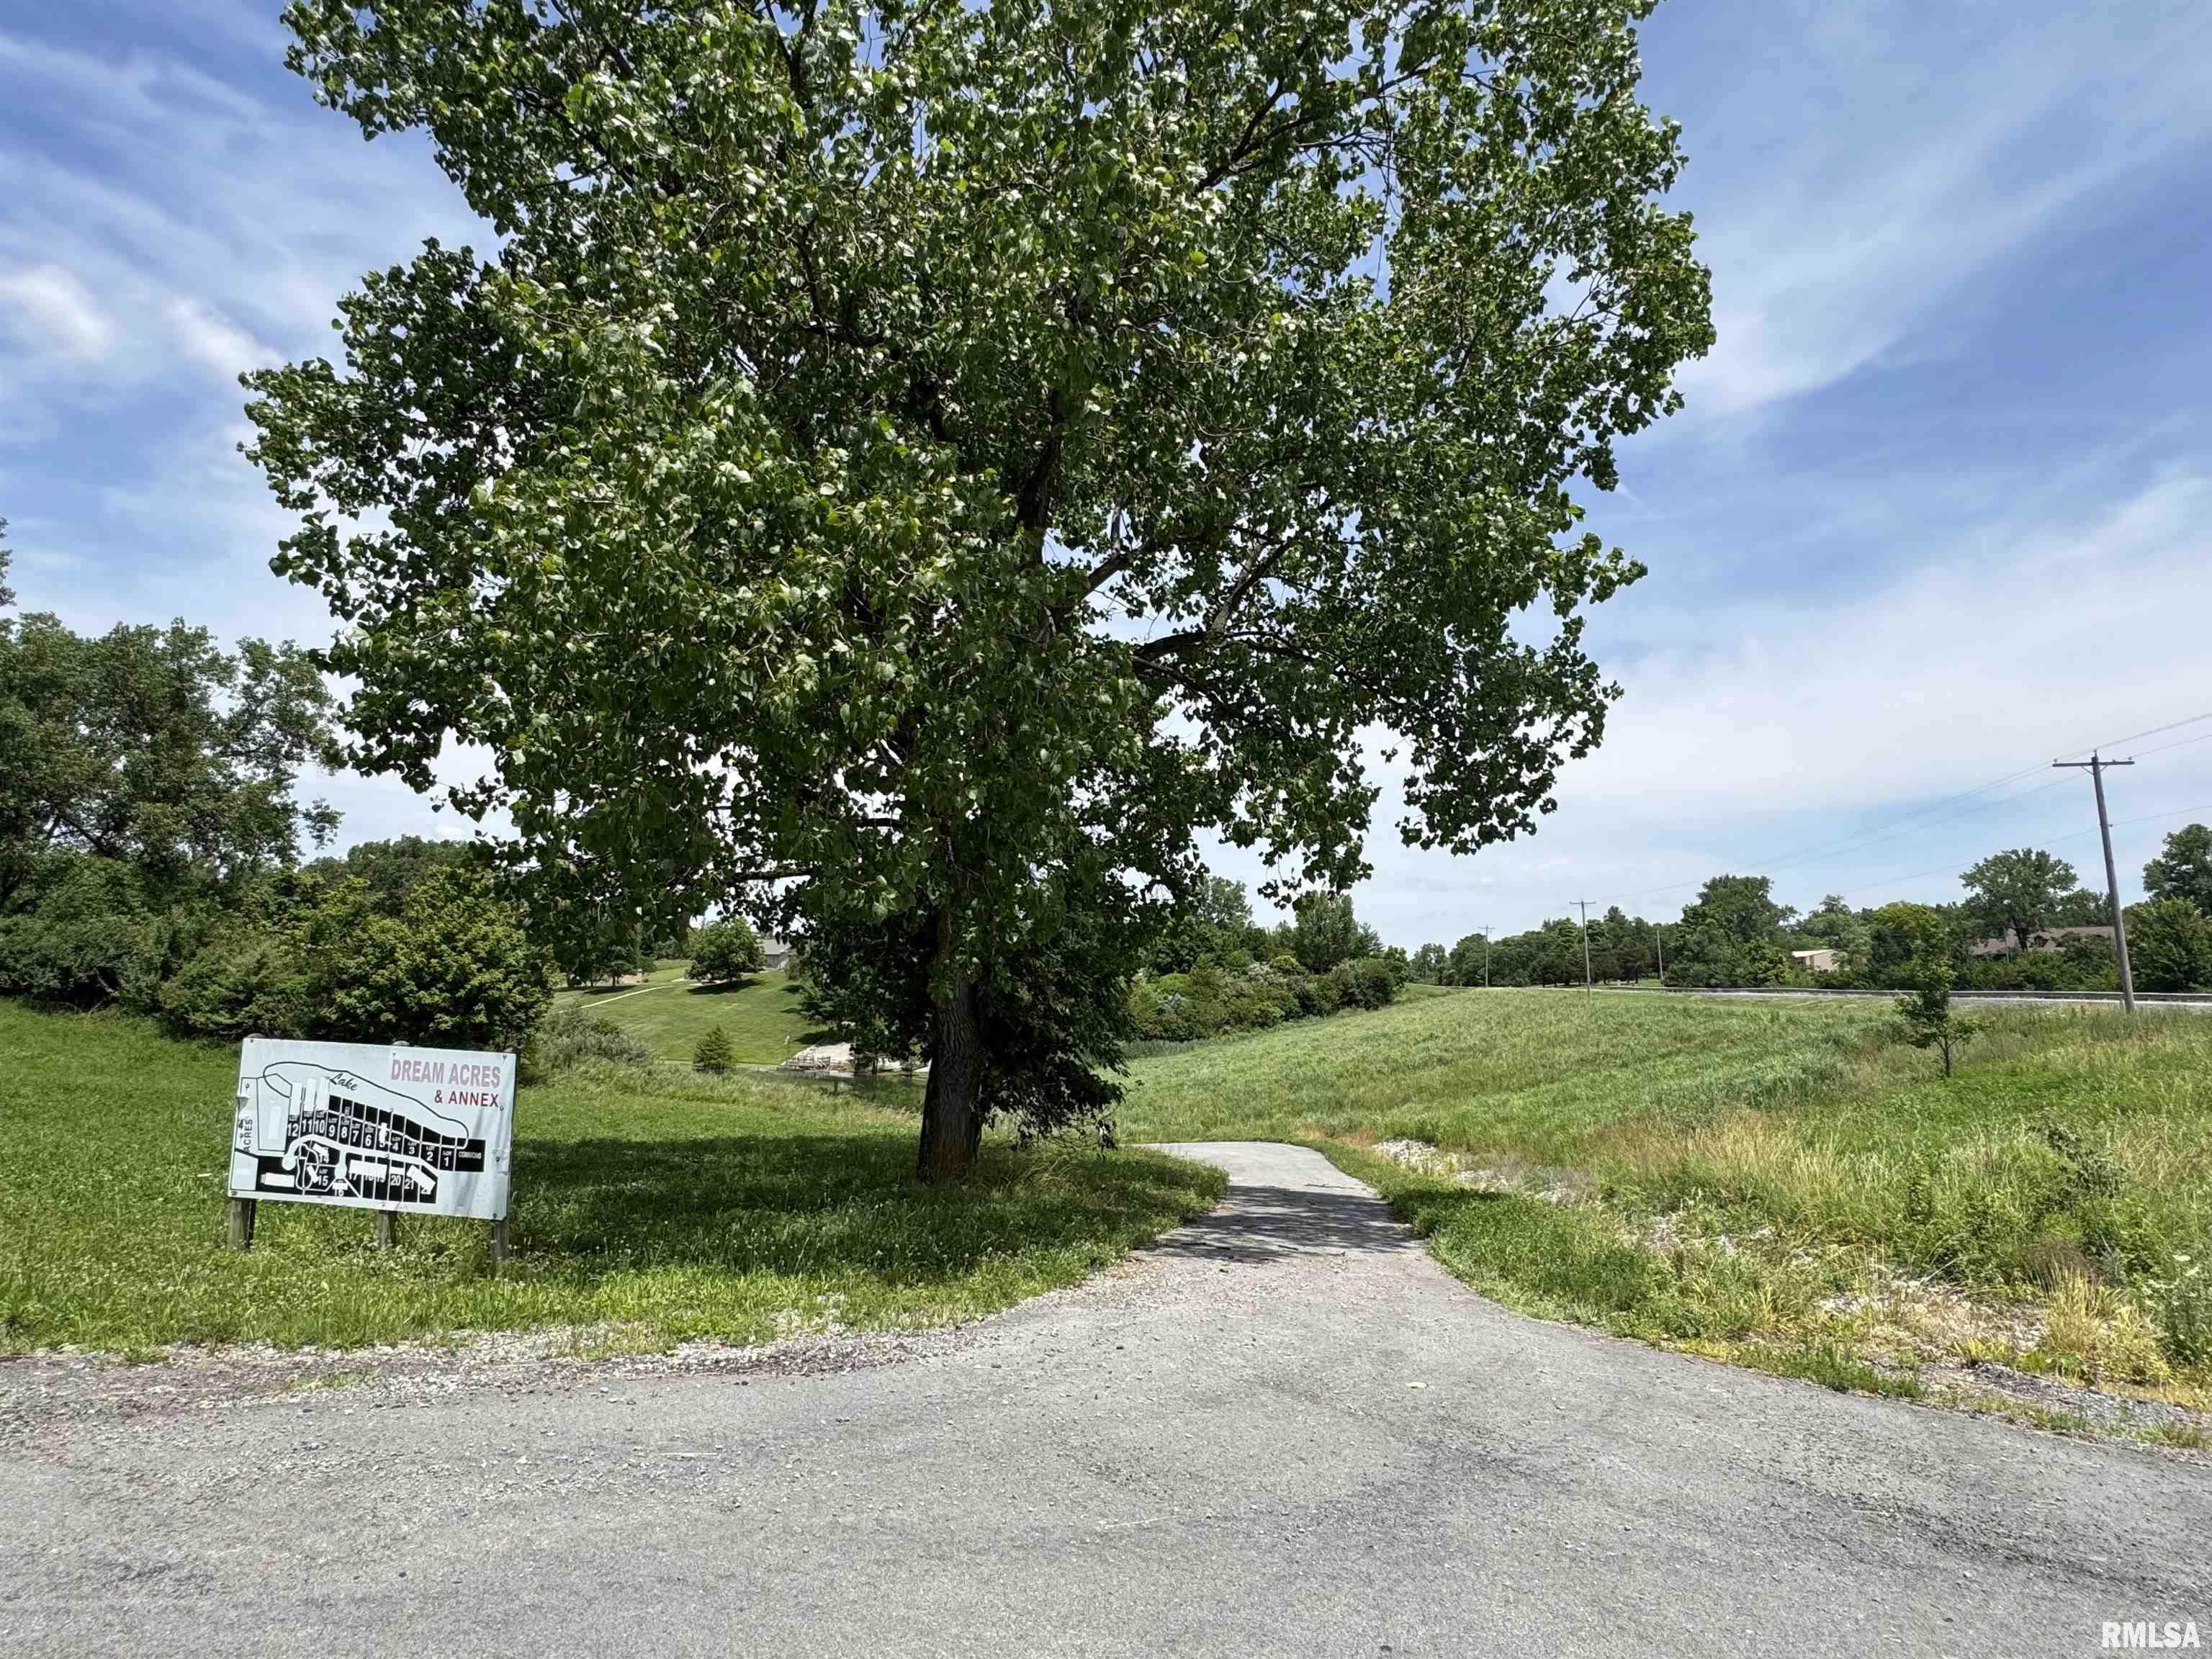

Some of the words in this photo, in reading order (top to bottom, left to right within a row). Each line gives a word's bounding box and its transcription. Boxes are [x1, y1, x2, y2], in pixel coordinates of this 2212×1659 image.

[391, 1059, 444, 1084] DREAM
[449, 1064, 500, 1089] ACRES
[329, 1073, 357, 1091] Lake
[434, 1089, 444, 1104] &
[449, 1091, 499, 1107] ANNEX
[288, 1123, 298, 1137] 12
[302, 1119, 312, 1133] 11
[315, 1120, 325, 1133] 10
[328, 1125, 336, 1138] 9
[341, 1126, 348, 1138] 8
[353, 1130, 359, 1142] 7
[365, 1134, 372, 1146] 6
[392, 1142, 399, 1151] 4
[408, 1146, 415, 1155] 3
[426, 1151, 433, 1161] 2
[444, 1156, 449, 1166] 1
[318, 1175, 328, 1187] 15
[391, 1175, 401, 1186] 20
[405, 1178, 415, 1190] 21
